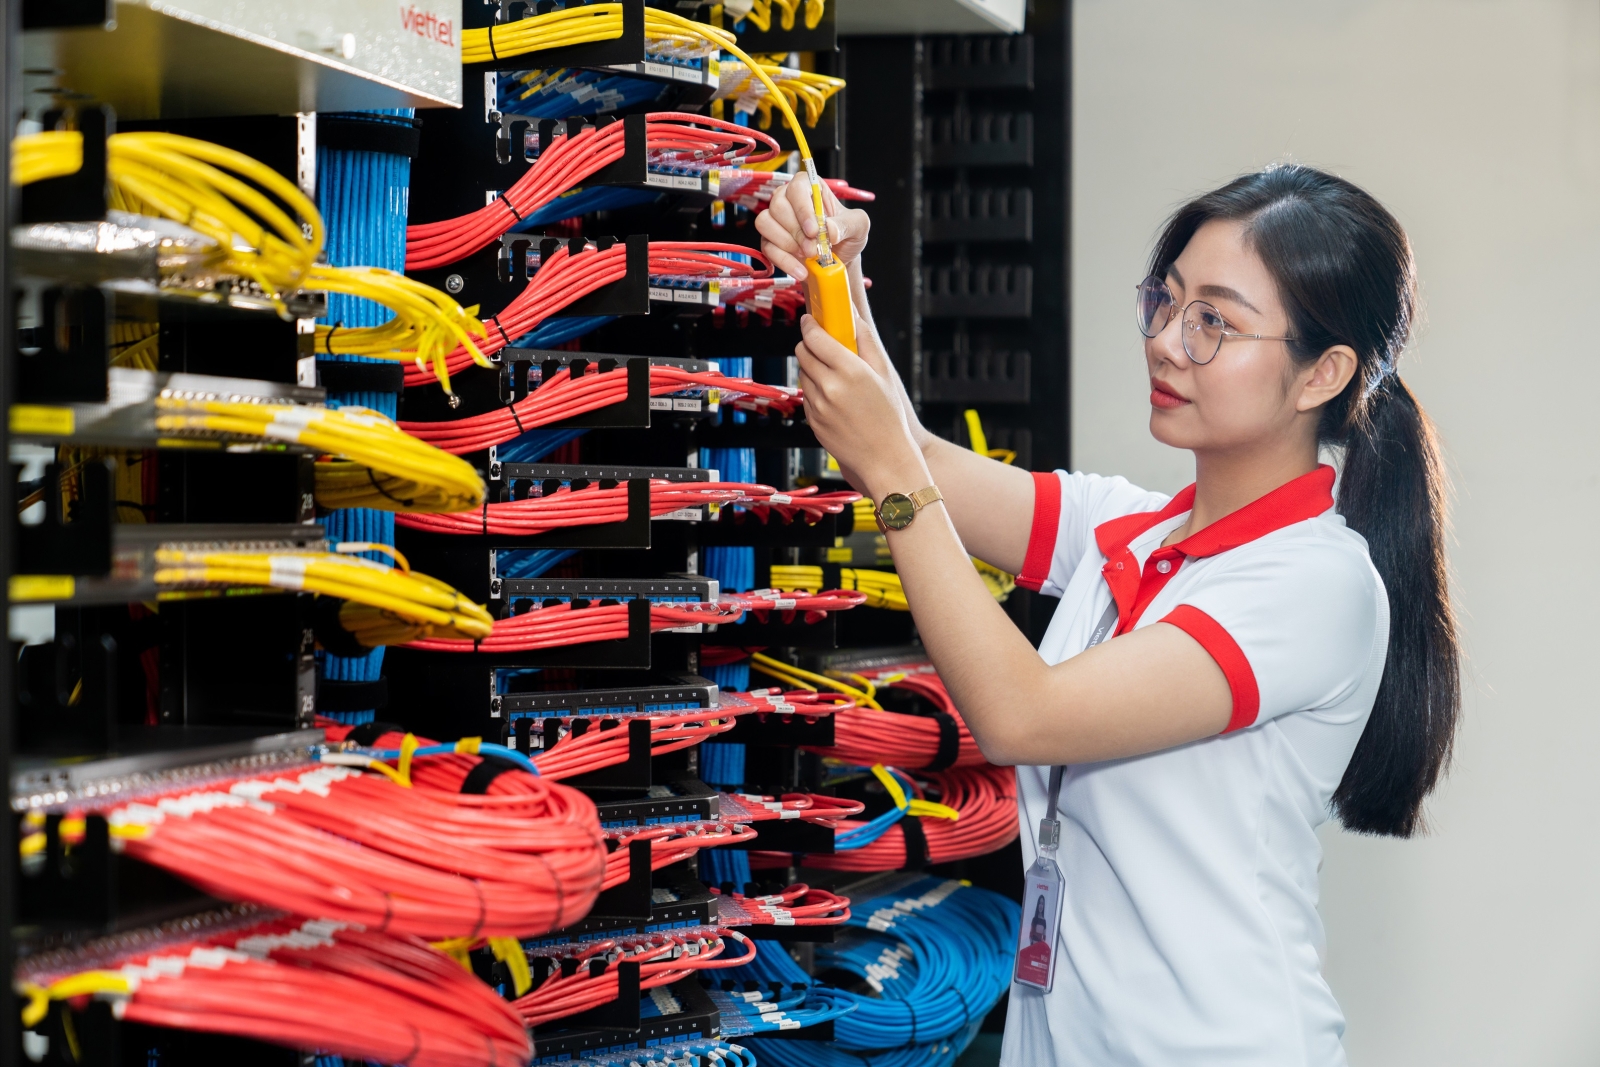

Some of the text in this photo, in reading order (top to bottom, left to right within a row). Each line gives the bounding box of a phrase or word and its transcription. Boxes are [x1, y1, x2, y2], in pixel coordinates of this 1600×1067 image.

[399, 4, 454, 48] viettel
[301, 222, 313, 241] 32
[302, 695, 314, 712] 25
